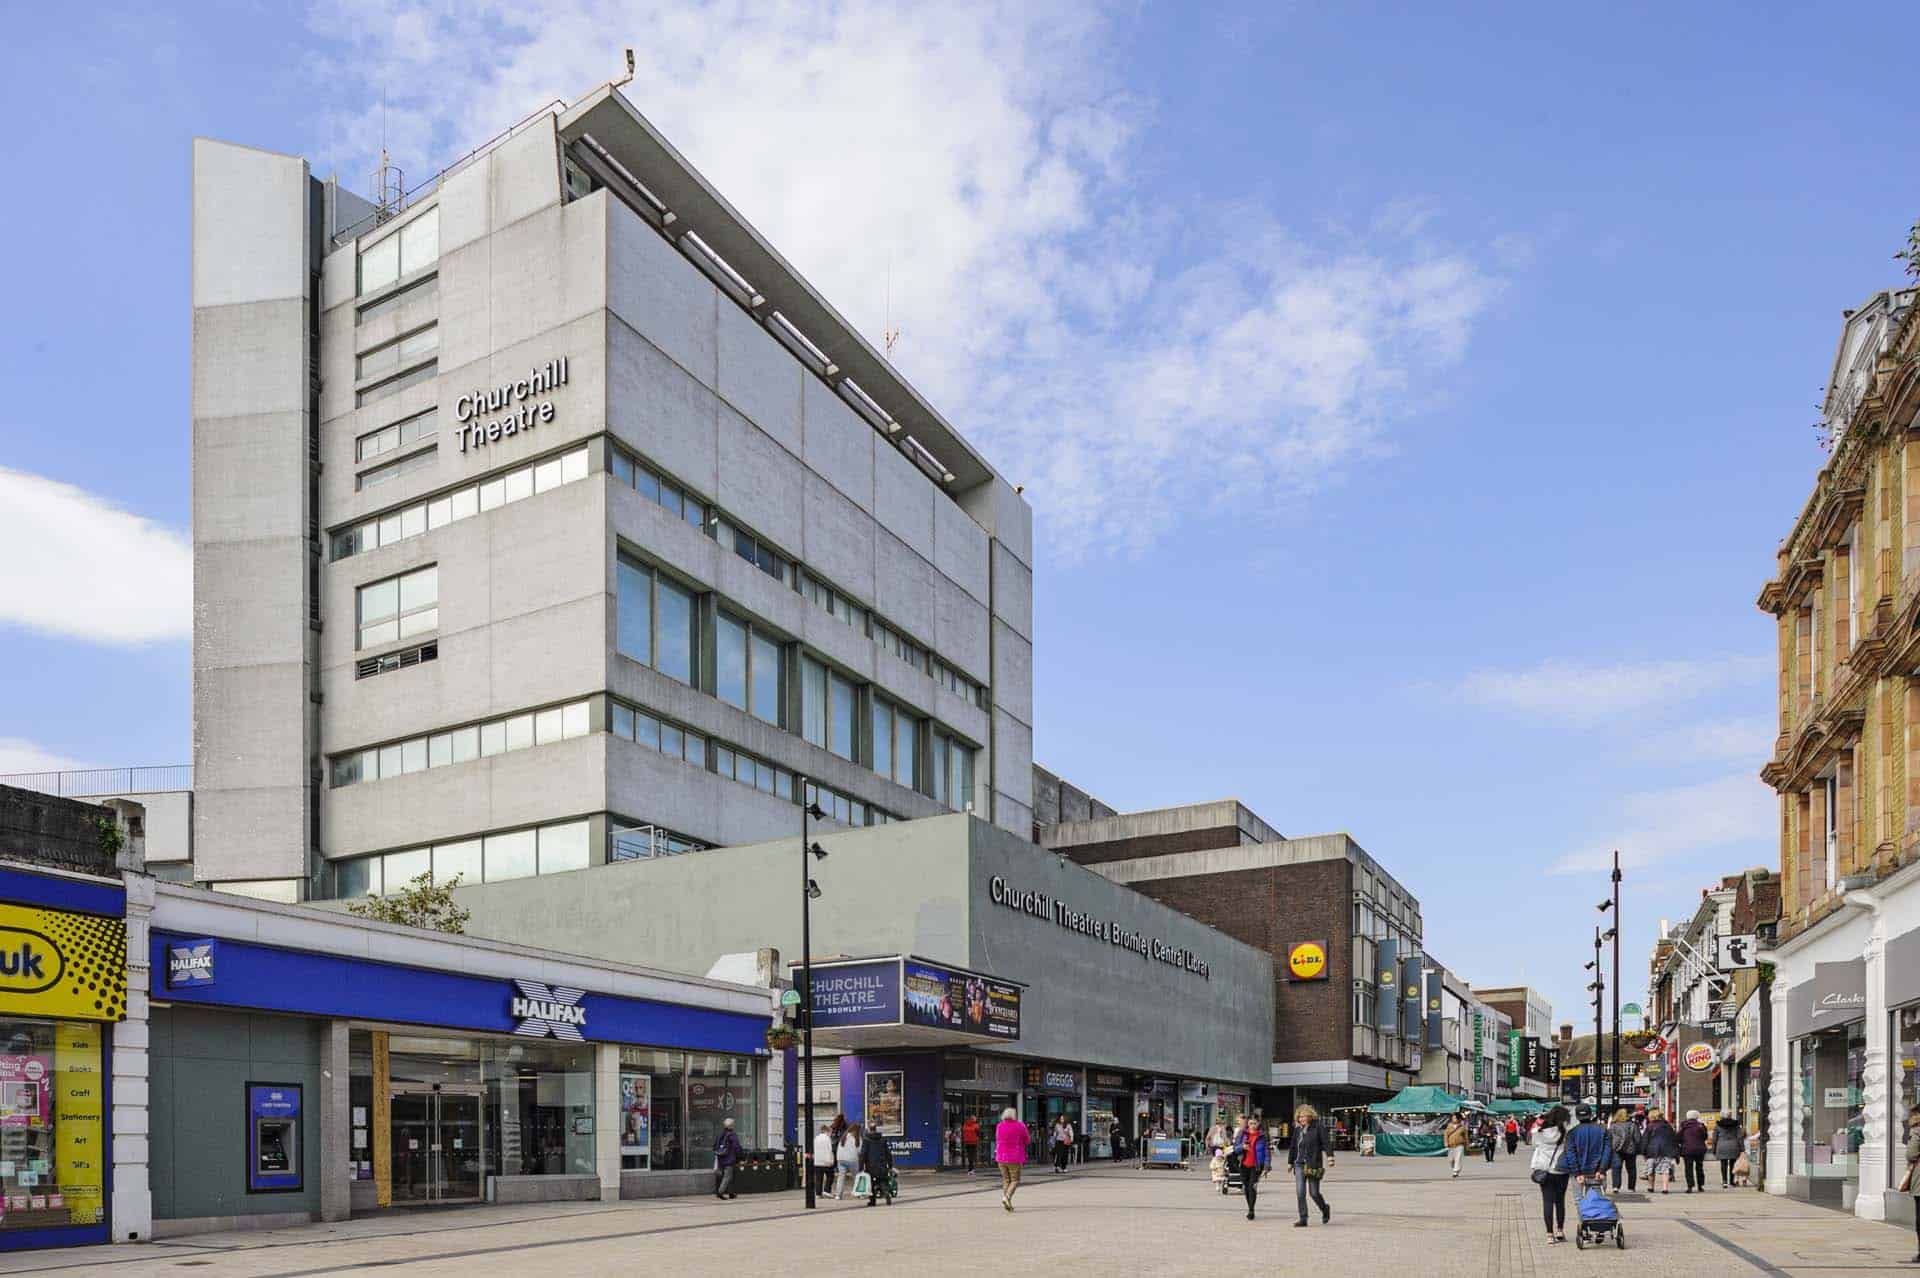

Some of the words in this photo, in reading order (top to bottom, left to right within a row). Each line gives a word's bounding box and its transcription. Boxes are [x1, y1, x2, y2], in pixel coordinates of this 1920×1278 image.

[456, 355, 568, 422] Churchill
[456, 400, 555, 453] Theatre
[990, 875, 1053, 920] Churchill
[1056, 900, 1101, 937] Theatre
[1102, 922, 1110, 940] &
[1111, 922, 1151, 960] Bromley
[1152, 938, 1185, 968] Central
[170, 956, 211, 971] HALIFAX
[814, 990, 876, 1006] THEATRE
[1822, 993, 1865, 1005] Clarks
[512, 997, 586, 1025] HALIFAX
[828, 1006, 862, 1014] BROMLEY
[1474, 1014, 1483, 1082] DEICHMANN
[1528, 1041, 1536, 1072] NEXT
[1689, 1054, 1711, 1065] KING
[1046, 1072, 1073, 1088] GREGGS
[70, 1088, 90, 1097] Craft
[60, 1113, 100, 1123] Stationery
[74, 1137, 87, 1145] Art
